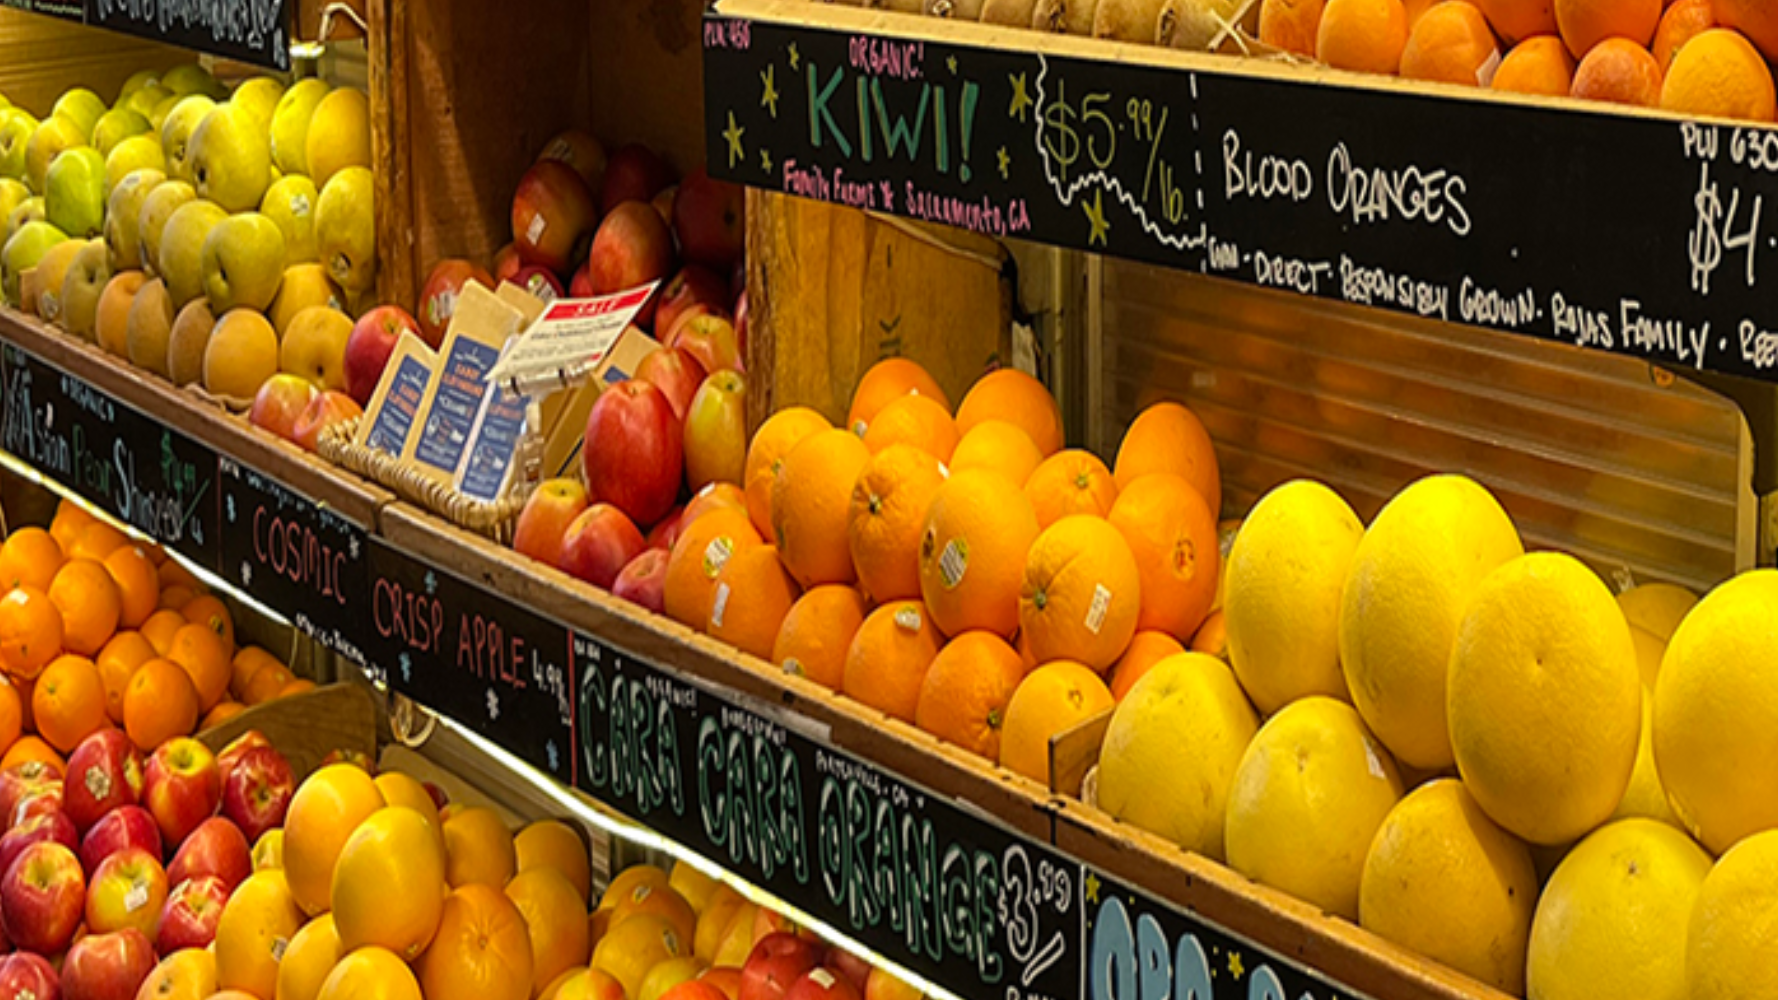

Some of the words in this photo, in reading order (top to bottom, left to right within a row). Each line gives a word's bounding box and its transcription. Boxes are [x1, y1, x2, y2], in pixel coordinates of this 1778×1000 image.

[849, 35, 924, 80] ORGANIC!
[808, 62, 978, 182] KIWI!
[783, 158, 830, 201] Family
[1008, 198, 1031, 232] CA
[1327, 142, 1471, 235] ORANGES
[1254, 250, 1331, 294] DIRECT
[1620, 297, 1710, 370] FAMILY
[253, 504, 347, 605] COSMIC
[372, 577, 443, 655] CRISP
[457, 613, 527, 690] APPLE
[579, 663, 685, 816] CARA
[697, 715, 809, 884] CARA
[818, 775, 1003, 982] ORANGE
